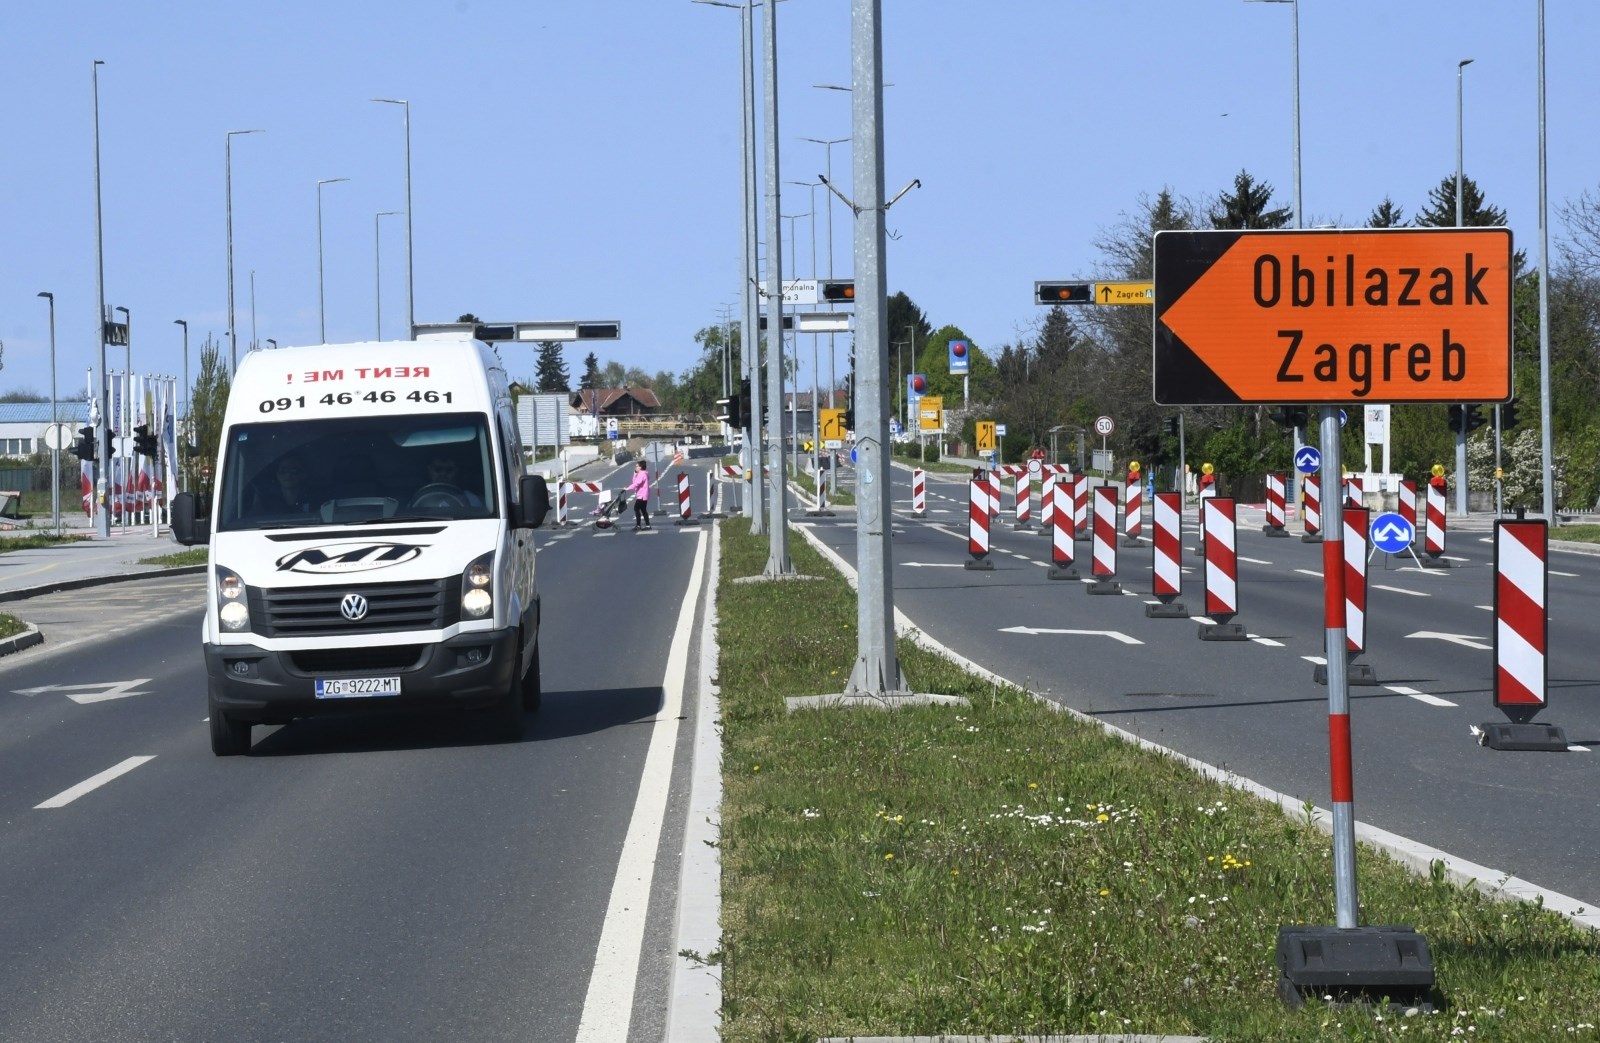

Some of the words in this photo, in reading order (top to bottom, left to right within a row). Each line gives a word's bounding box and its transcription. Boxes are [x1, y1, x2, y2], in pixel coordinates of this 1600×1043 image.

[1254, 253, 1489, 308] Obilazak
[1116, 290, 1144, 299] Zagreb
[1276, 328, 1466, 397] Zagreb
[259, 396, 305, 413] 091
[319, 393, 353, 406] 46
[363, 391, 396, 403] 46
[406, 391, 452, 404] 461
[1099, 421, 1111, 431] 50
[325, 681, 341, 694] ZG
